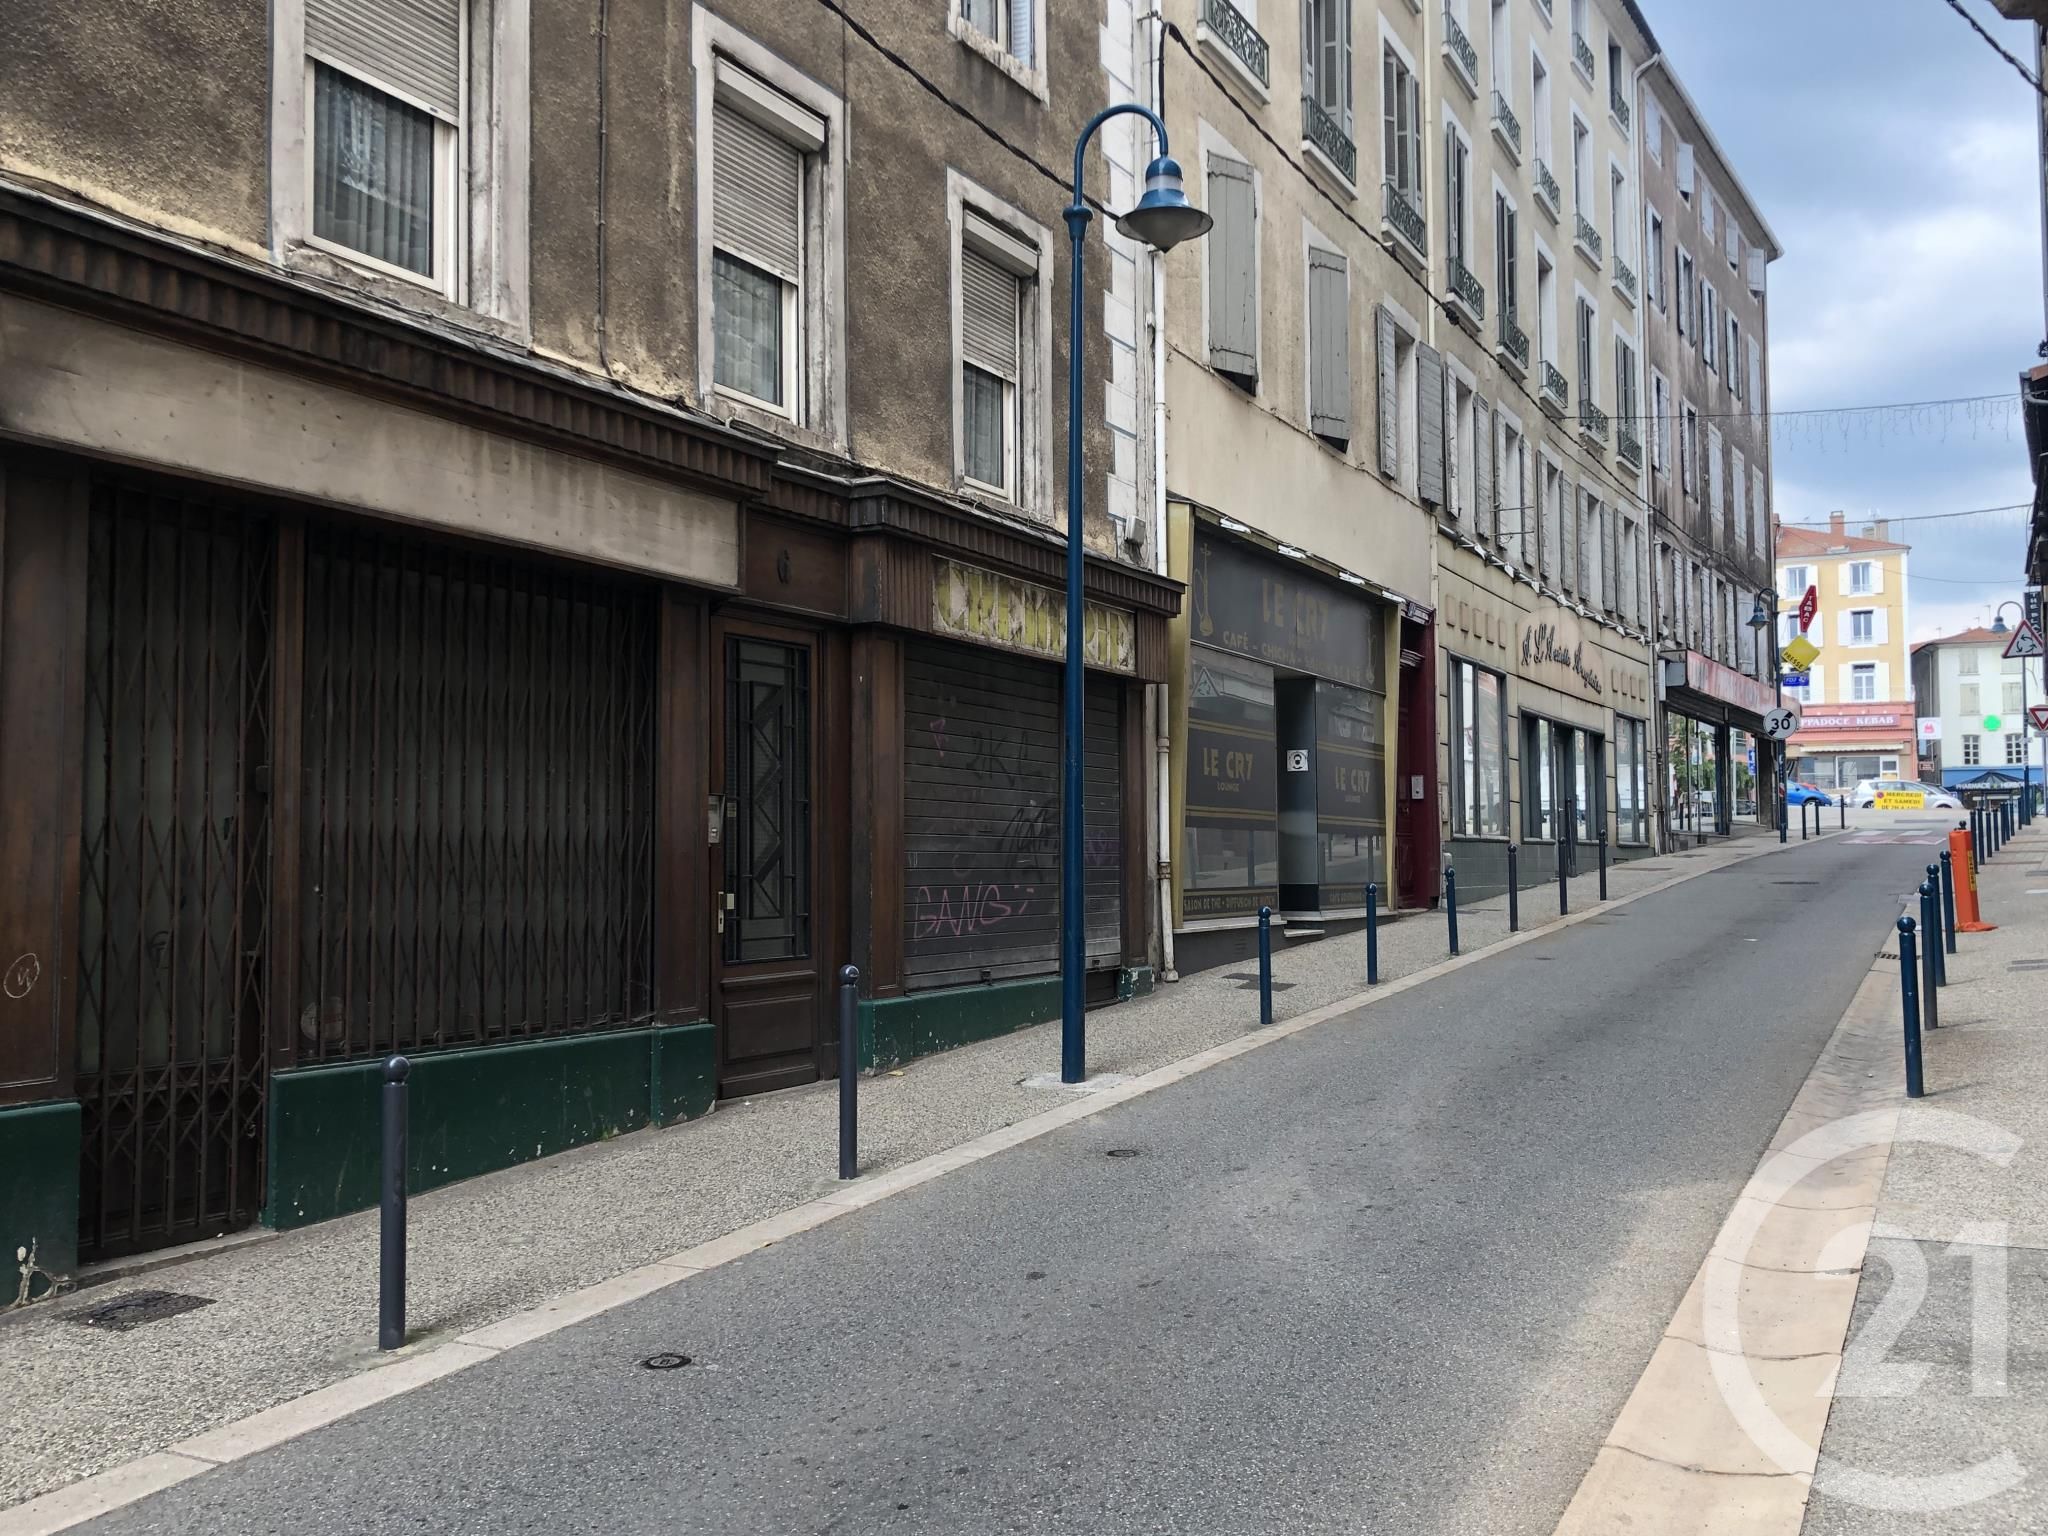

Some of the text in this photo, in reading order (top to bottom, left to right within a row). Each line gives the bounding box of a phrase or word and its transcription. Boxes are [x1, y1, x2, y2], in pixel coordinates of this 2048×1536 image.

[1262, 578, 1285, 627] LE
[1803, 595, 1813, 623] TABAC
[1223, 631, 1249, 650] CAFÉ
[1783, 651, 1804, 669] PRESSE
[1771, 718, 1791, 730] 30
[1800, 716, 1894, 727] PPADOCE KEBAB
[1203, 747, 1219, 777] LE
[1226, 751, 1253, 782] CR7
[1334, 767, 1371, 794] LE CR7
